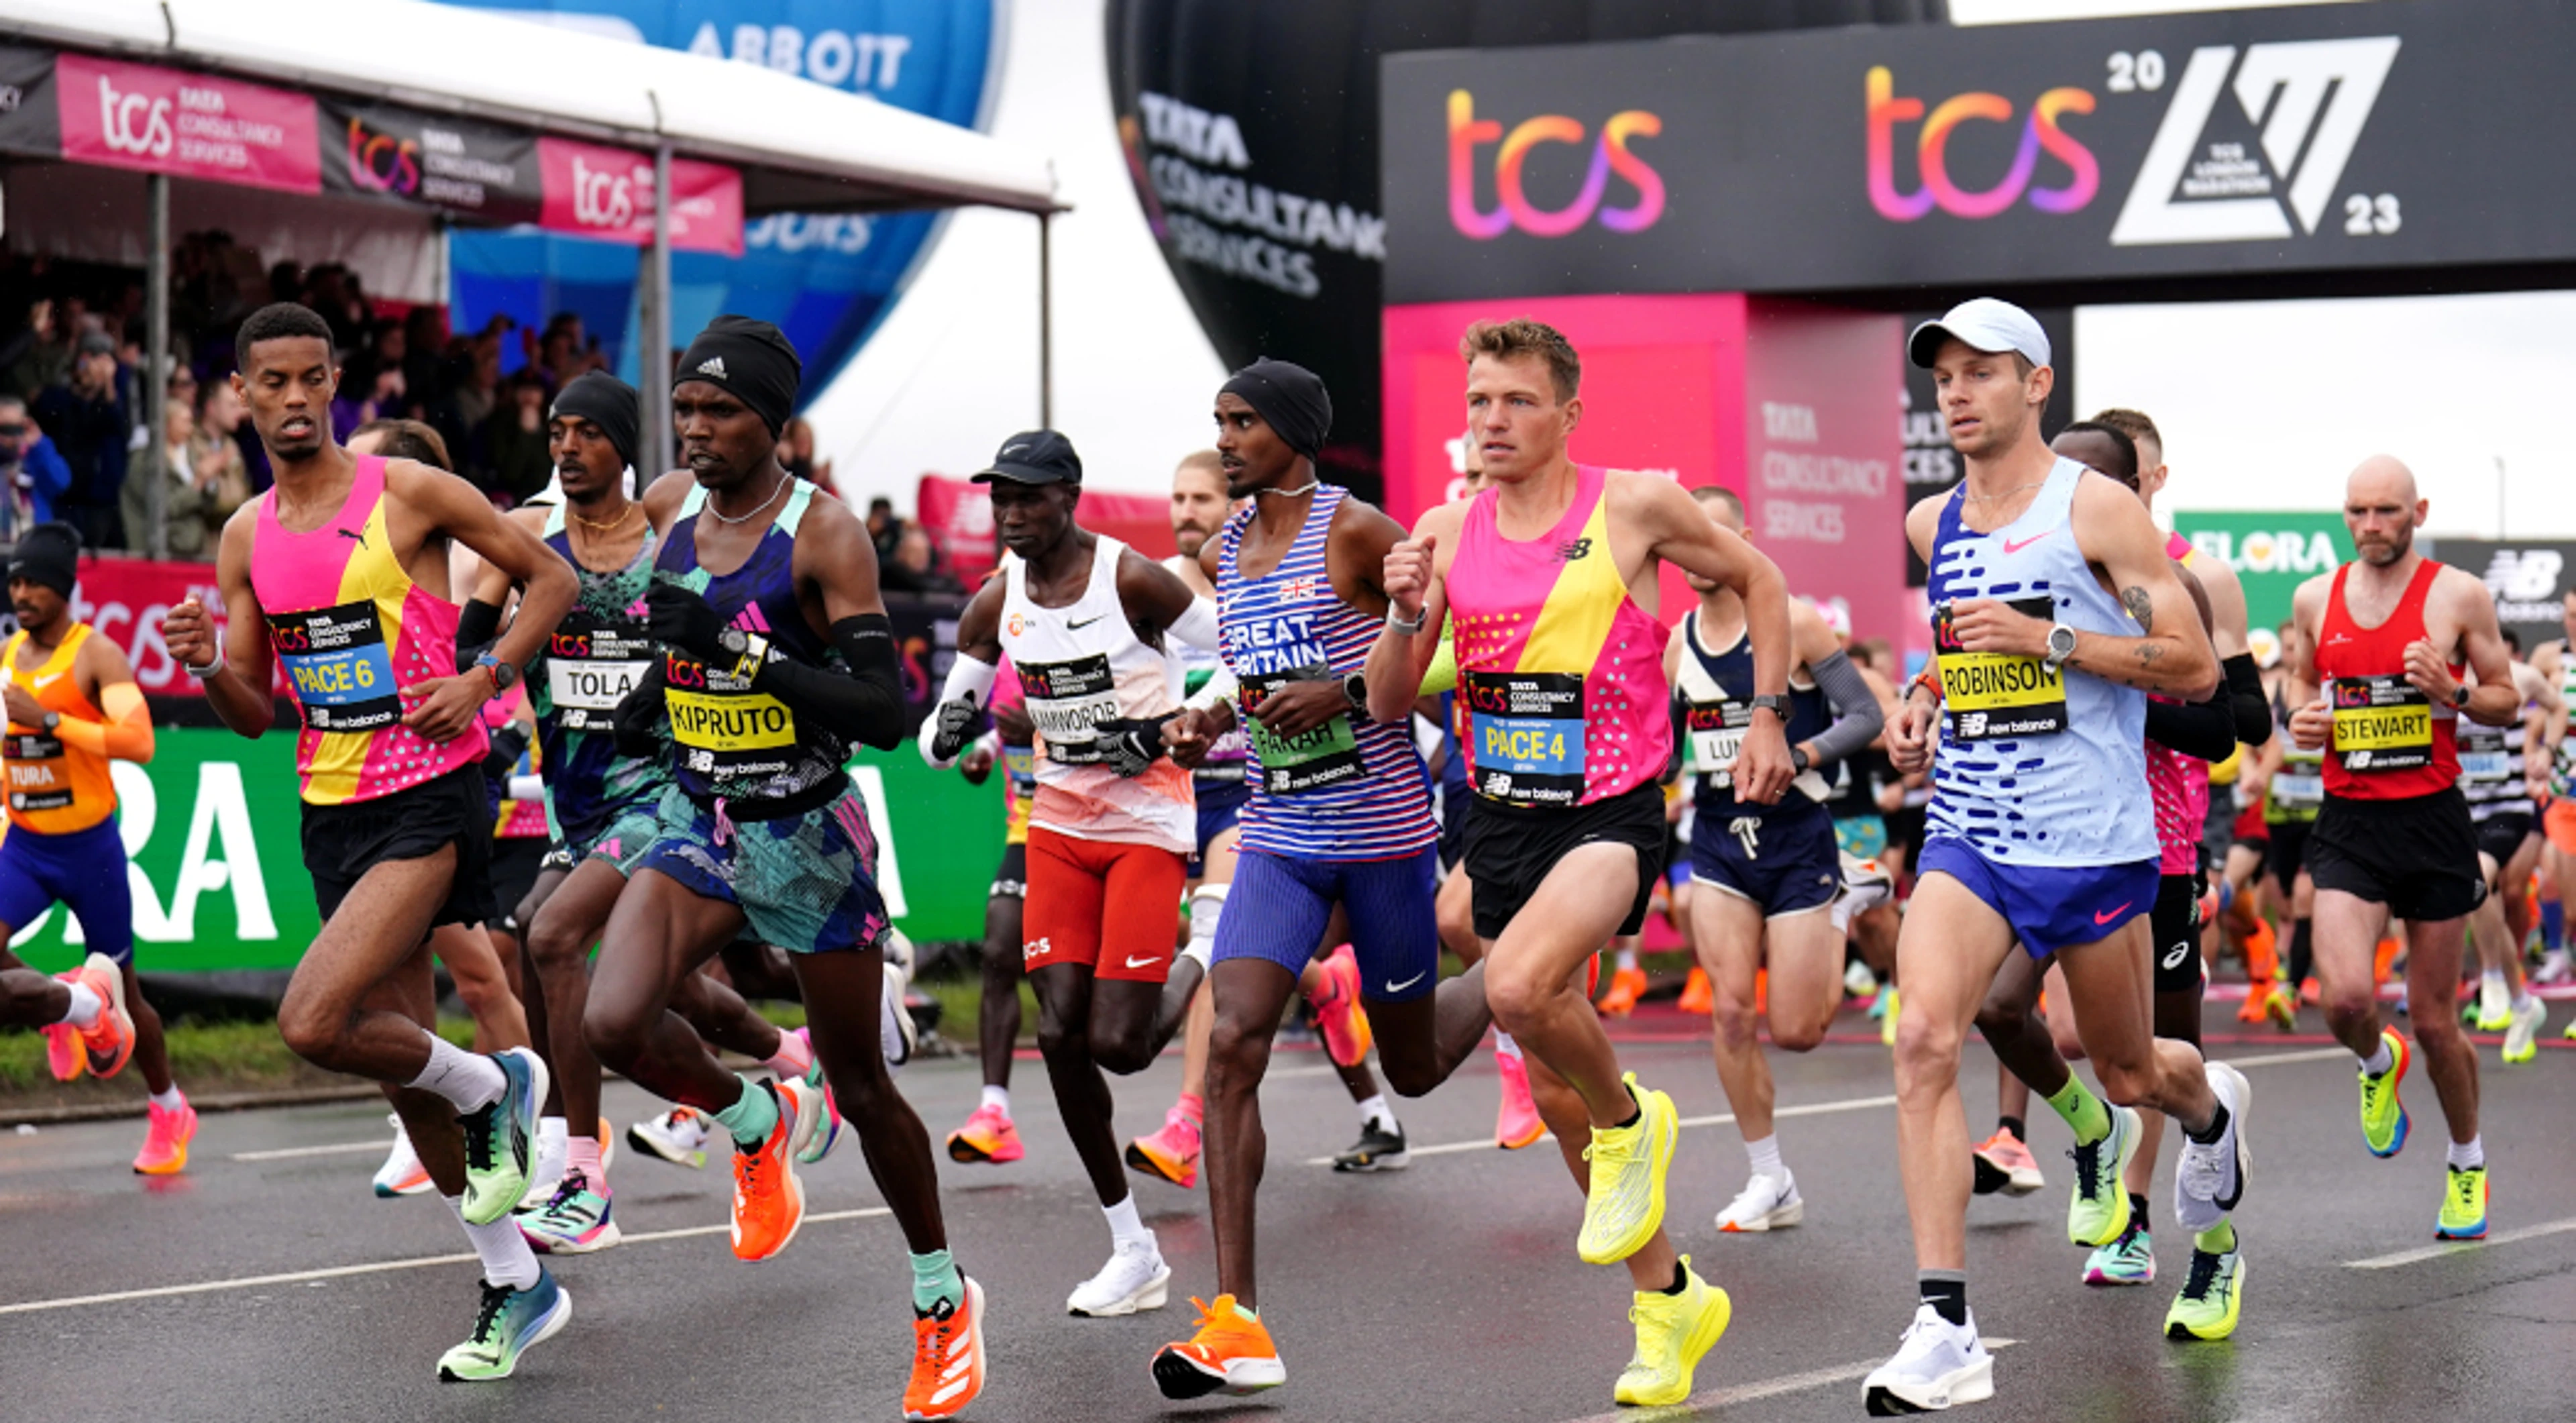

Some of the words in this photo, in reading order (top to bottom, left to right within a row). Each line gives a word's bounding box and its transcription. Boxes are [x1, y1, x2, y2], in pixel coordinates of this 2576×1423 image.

[688, 21, 911, 90] ABBOTT
[2107, 50, 2165, 92] 20
[99, 74, 172, 156] tcs
[1140, 91, 1249, 169] TATA
[349, 117, 418, 197] tcs
[1447, 89, 1666, 240] tcs
[1866, 66, 2100, 221] tcs
[573, 156, 632, 227] tcs
[1149, 153, 1387, 260] CONSULTANC
[2345, 193, 2402, 235] 23
[1762, 401, 1819, 443] TATA
[1764, 450, 1890, 498] CONSULTANCY
[1764, 498, 1845, 543] SERVICES
[2191, 530, 2340, 574] FLORA
[551, 633, 590, 656] tcs
[1236, 640, 1326, 675] RITAIN
[293, 662, 354, 692] PACE
[355, 660, 374, 687] 6
[568, 672, 631, 696] TOLA
[667, 652, 704, 687] tcs
[1509, 682, 1539, 690] TATA
[1945, 660, 2057, 696] ROBINSON
[1510, 691, 1575, 702] CONSULTANCY
[2337, 683, 2370, 706] tcs
[672, 703, 785, 737] KIPRUTO
[1988, 722, 2010, 735] new
[2010, 718, 2057, 733] balance
[2337, 714, 2426, 741] STEWART
[1486, 727, 1546, 760] PACE
[1550, 733, 1566, 761] 4
[10, 765, 55, 786] TURA
[64, 759, 279, 945] RA
